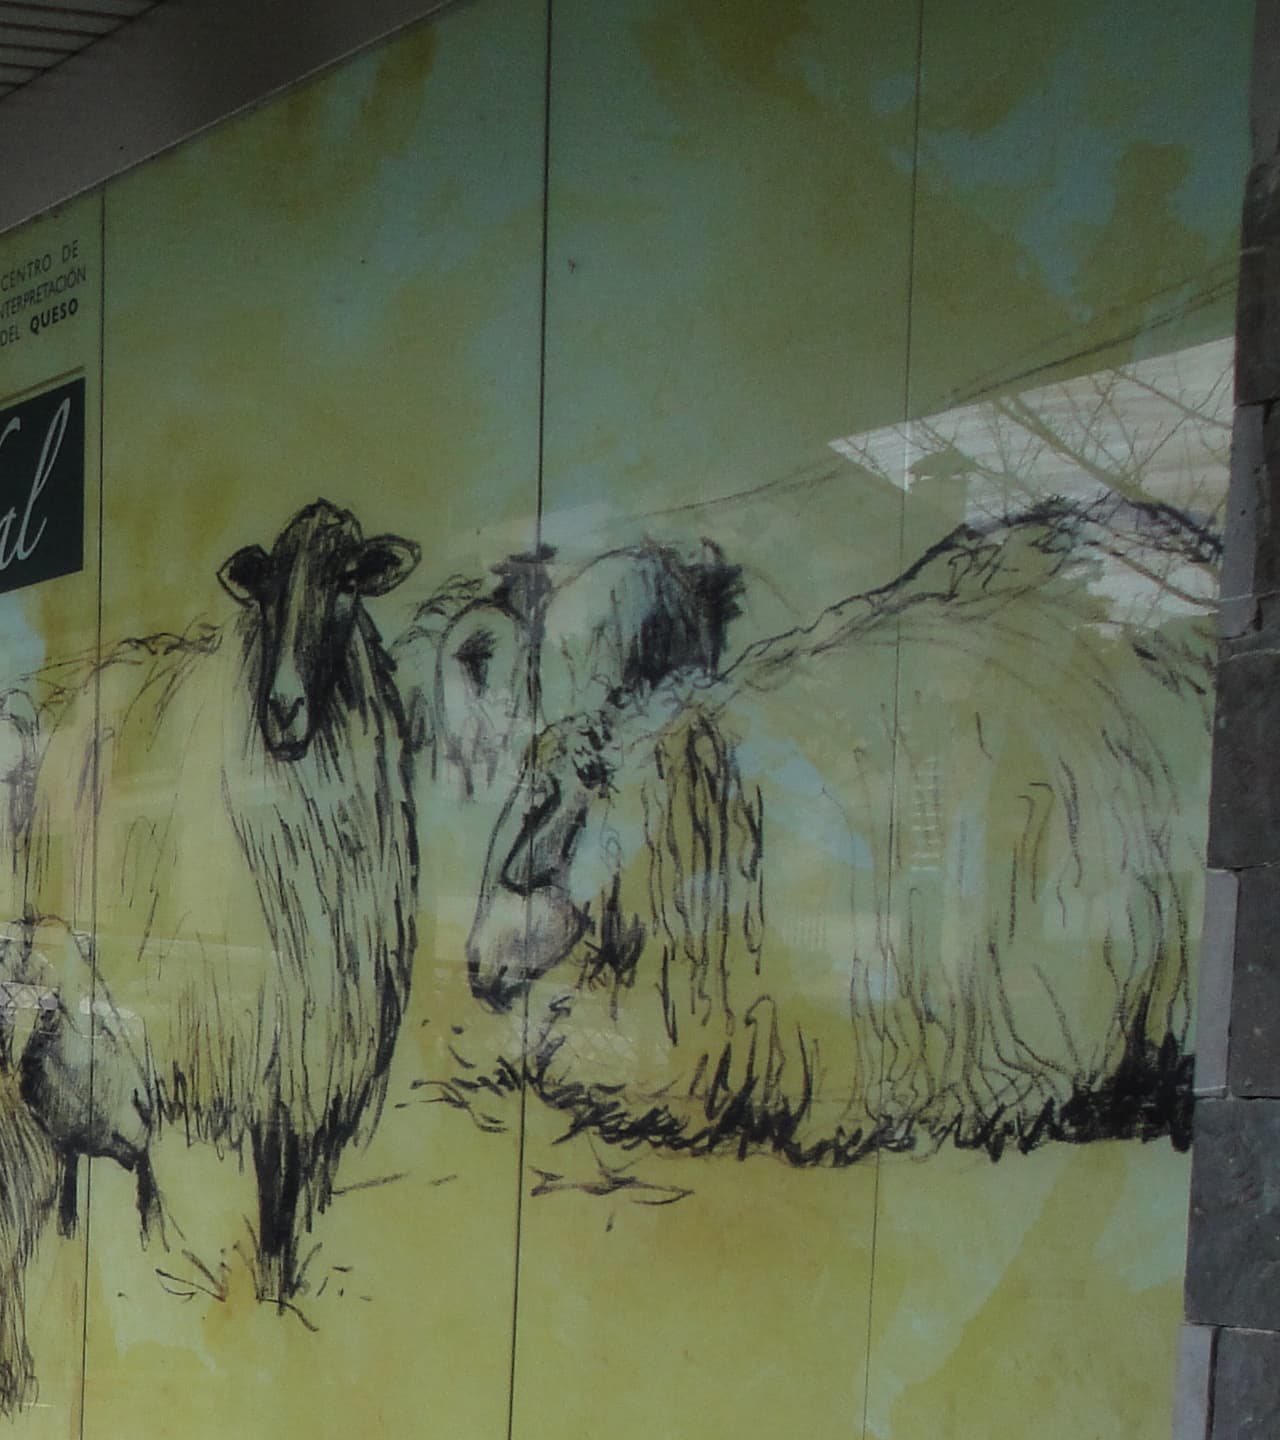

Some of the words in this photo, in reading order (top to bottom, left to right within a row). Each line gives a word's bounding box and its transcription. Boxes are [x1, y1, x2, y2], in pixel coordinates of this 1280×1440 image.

[1, 253, 52, 292] CENTRO
[62, 239, 80, 264] DE
[0, 324, 21, 347] DEL
[30, 298, 79, 336] QUESO
